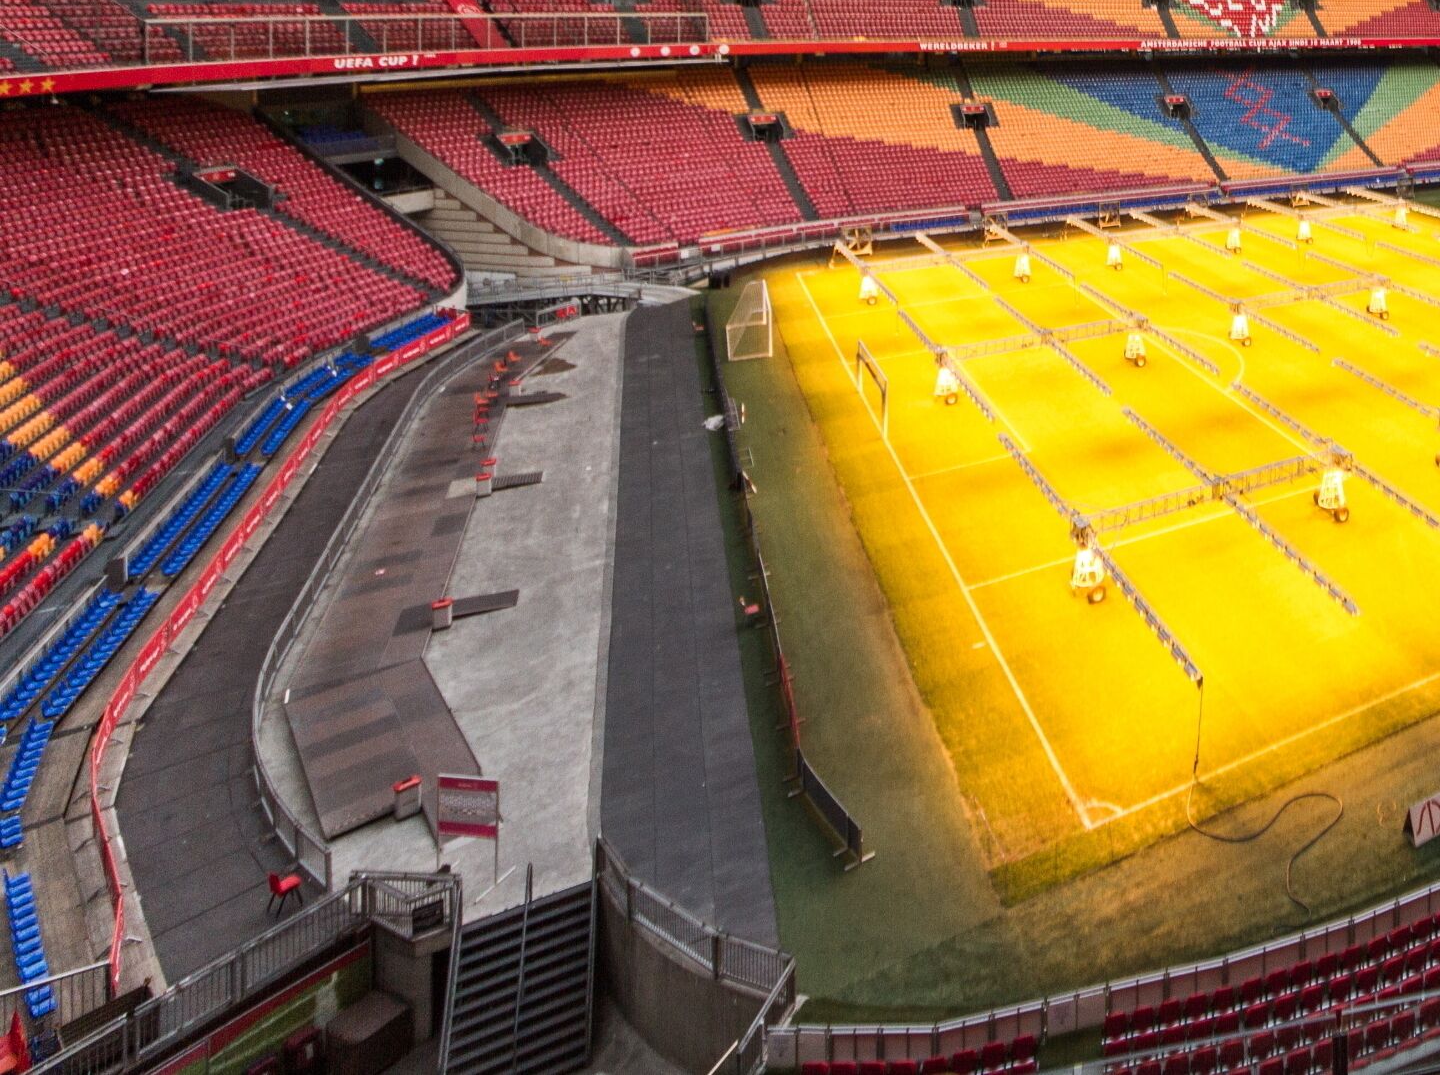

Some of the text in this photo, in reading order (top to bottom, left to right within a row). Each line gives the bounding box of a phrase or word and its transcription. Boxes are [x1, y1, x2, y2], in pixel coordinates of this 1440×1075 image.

[920, 42, 988, 50] WERELDBEKER
[334, 55, 408, 69] UEFA CUP
